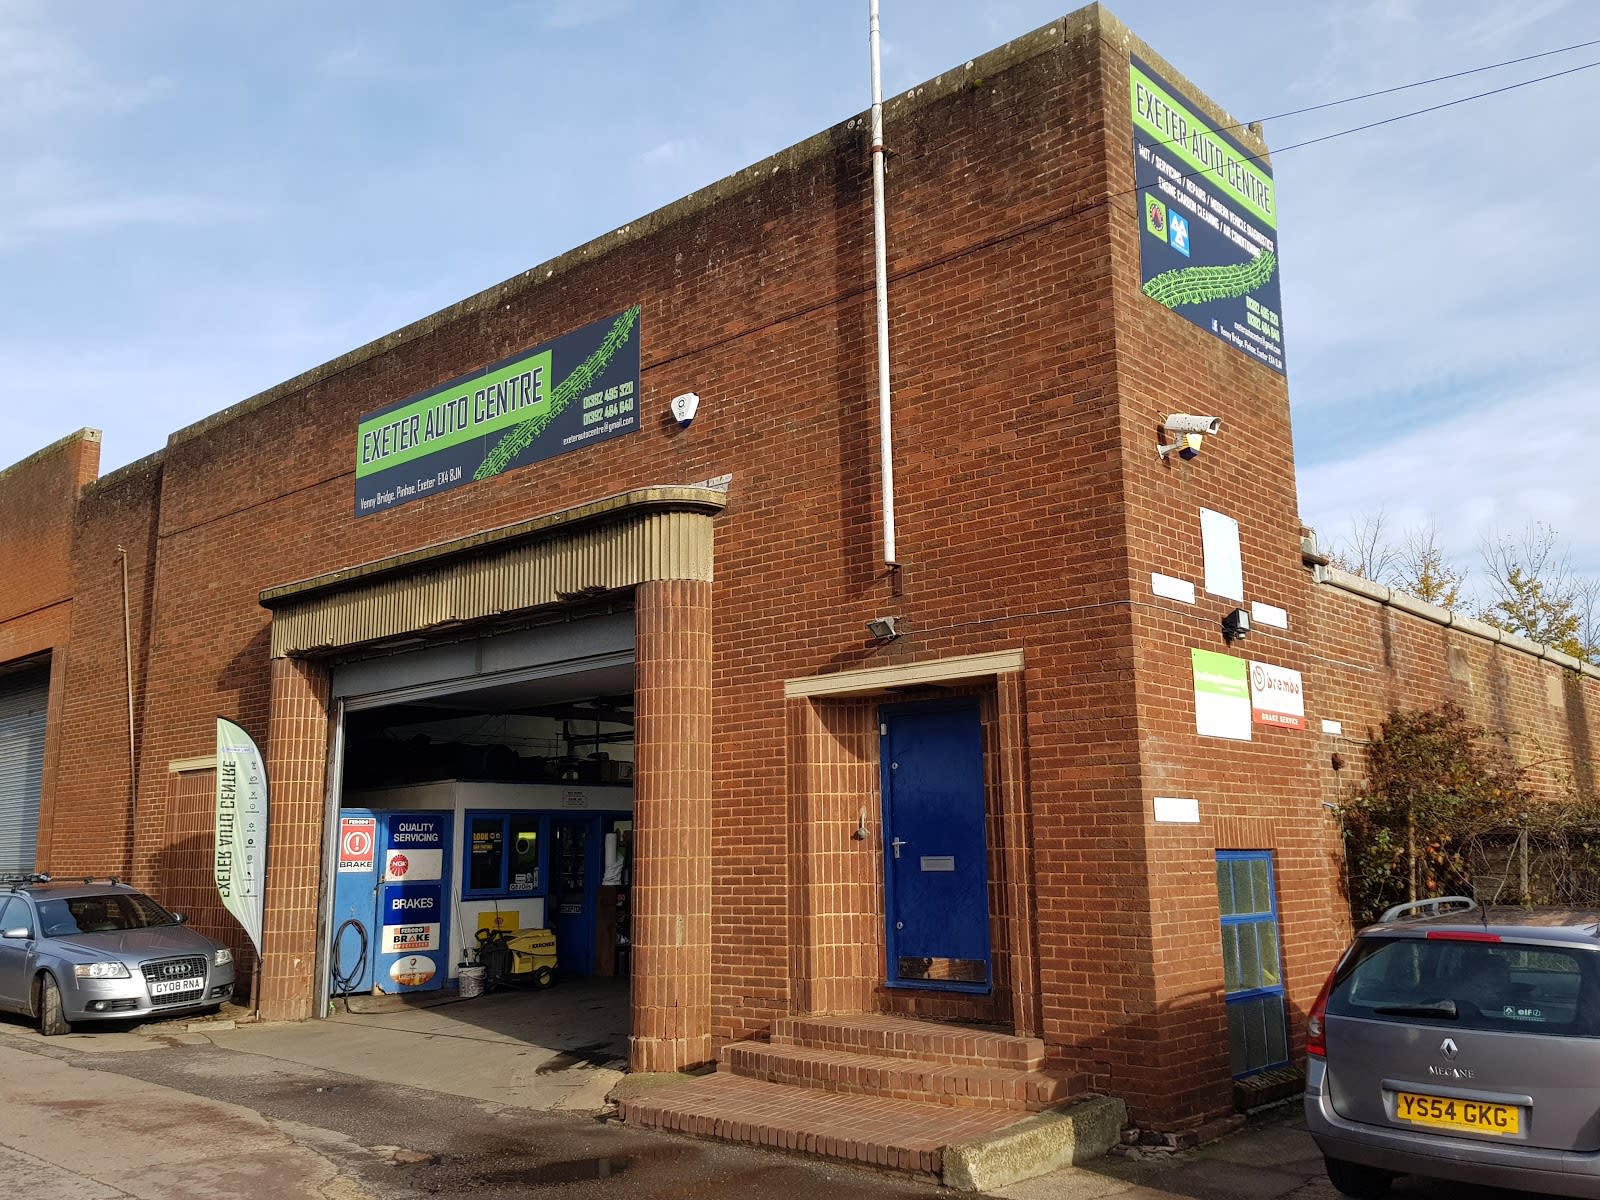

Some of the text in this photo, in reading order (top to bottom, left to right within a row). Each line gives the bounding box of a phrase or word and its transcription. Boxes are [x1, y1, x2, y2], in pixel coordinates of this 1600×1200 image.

[1136, 82, 1271, 215] EXETER AUTO CENTRE
[1139, 144, 1150, 162] MOT
[362, 366, 543, 466] EXETER AUTO CENTRE
[563, 417, 633, 445] exeterautocentre@gmail.com
[361, 498, 376, 510] Venny
[377, 490, 395, 504] Bridge,
[418, 478, 435, 492] Exeter
[438, 471, 448, 485] EX4
[449, 466, 462, 482] 8JN
[1267, 672, 1299, 694] brembo
[1262, 713, 1299, 726] BRAKE SERVICE
[399, 823, 434, 832] QUALITY
[394, 833, 438, 842] SERVICING
[392, 898, 433, 910] BRAKES
[157, 979, 200, 992] GY08 RNA
[1428, 1065, 1475, 1079] MEGANE
[1403, 1096, 1509, 1128] YS54 GKG
